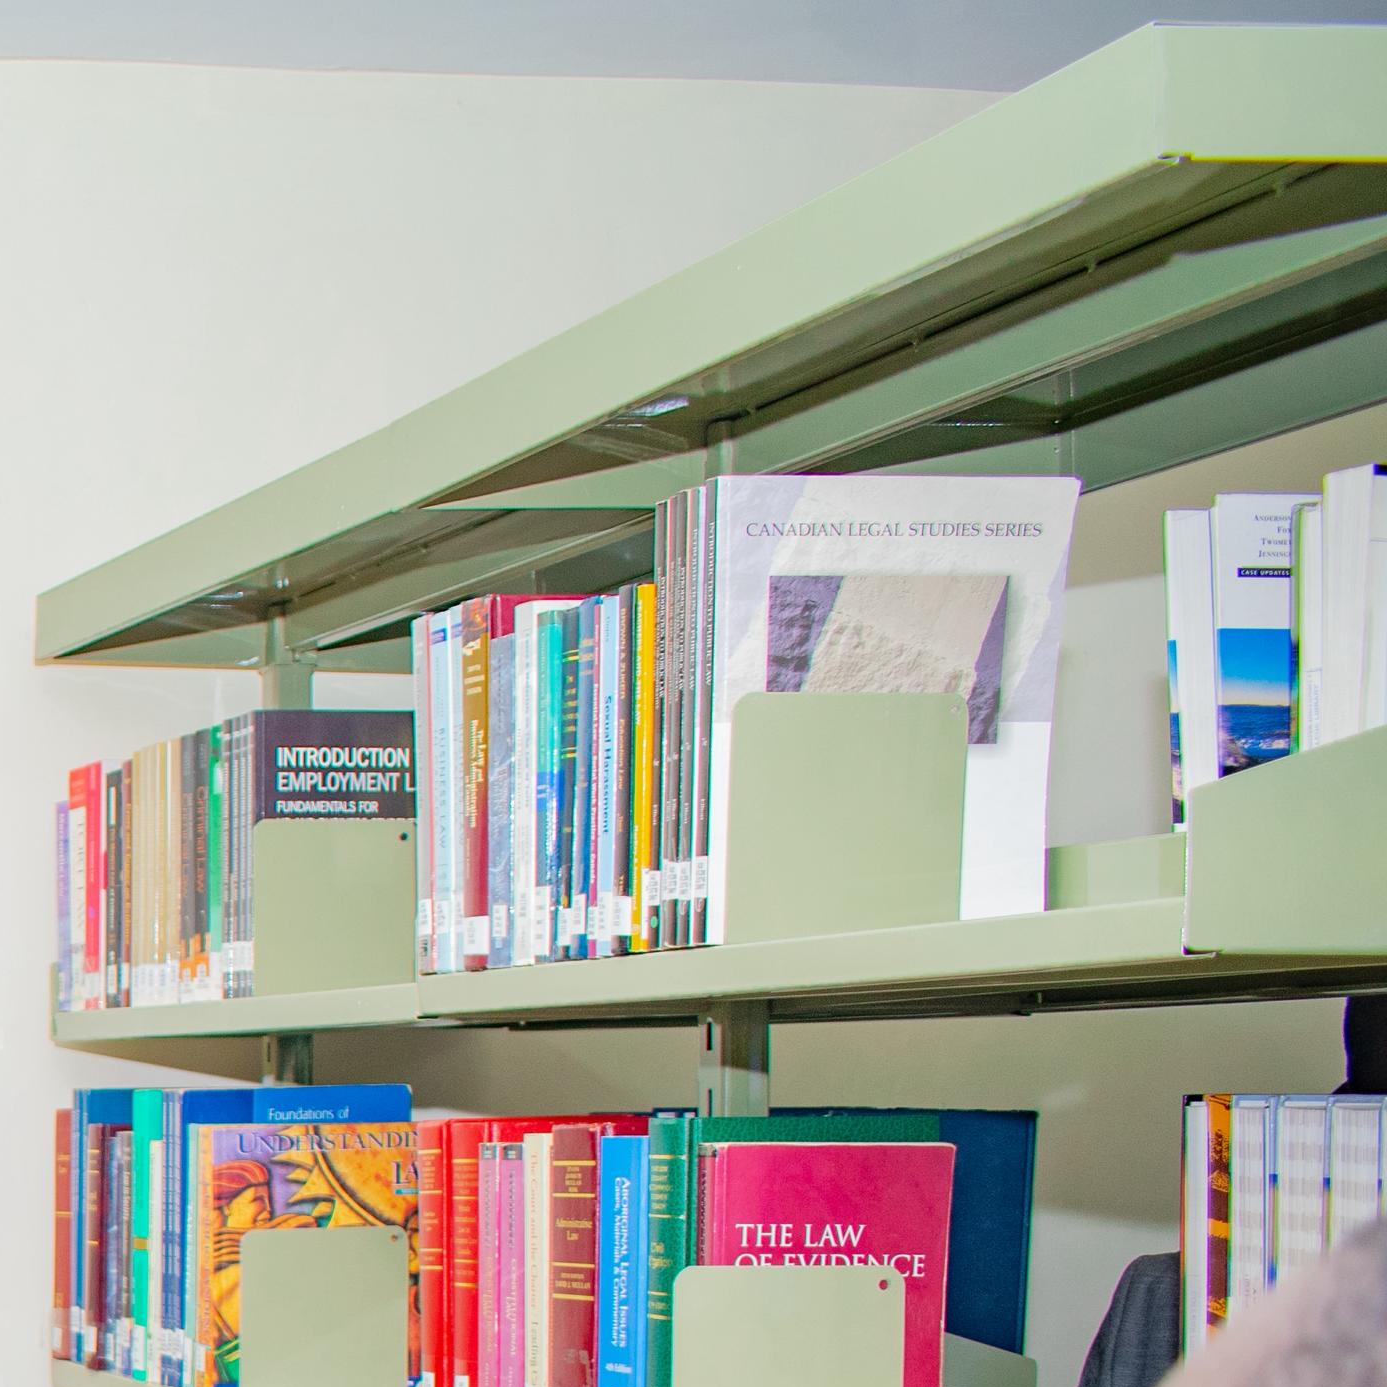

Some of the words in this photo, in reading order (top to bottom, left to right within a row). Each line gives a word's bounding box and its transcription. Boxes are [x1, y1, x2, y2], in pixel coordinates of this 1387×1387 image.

[746, 522, 843, 537] CANADIAN
[848, 522, 904, 537] LEGAL
[908, 522, 980, 537] STUDIES
[984, 522, 1043, 537] SERIES
[604, 696, 612, 742] Sexual
[276, 746, 410, 768] INTRODUCTION
[438, 727, 446, 802] BUSINESS
[276, 771, 400, 793] EMPLOYMENT
[603, 748, 612, 833] Harassment
[195, 786, 206, 853] Criminal
[275, 800, 357, 814] FUNDAMENTALS
[357, 800, 379, 813] FOR
[438, 814, 446, 849] LAW
[195, 857, 205, 893] Law
[268, 1106, 335, 1121] Foundations
[338, 1106, 350, 1120] of
[237, 1130, 418, 1154] UNDERSTANDI
[612, 1176, 622, 1211] Cases,
[555, 1217, 593, 1228] Administrative
[619, 1177, 631, 1257] ABORIGINAL
[566, 1230, 579, 1241] Law
[612, 1214, 622, 1263] Materials
[734, 1223, 793, 1248] THE
[804, 1223, 867, 1248] LAW
[619, 1261, 630, 1301] LEGAL
[509, 1258, 517, 1356] CONSTITUTIONAL
[610, 1277, 621, 1347] Commentary
[618, 1305, 629, 1348] ISSUES
